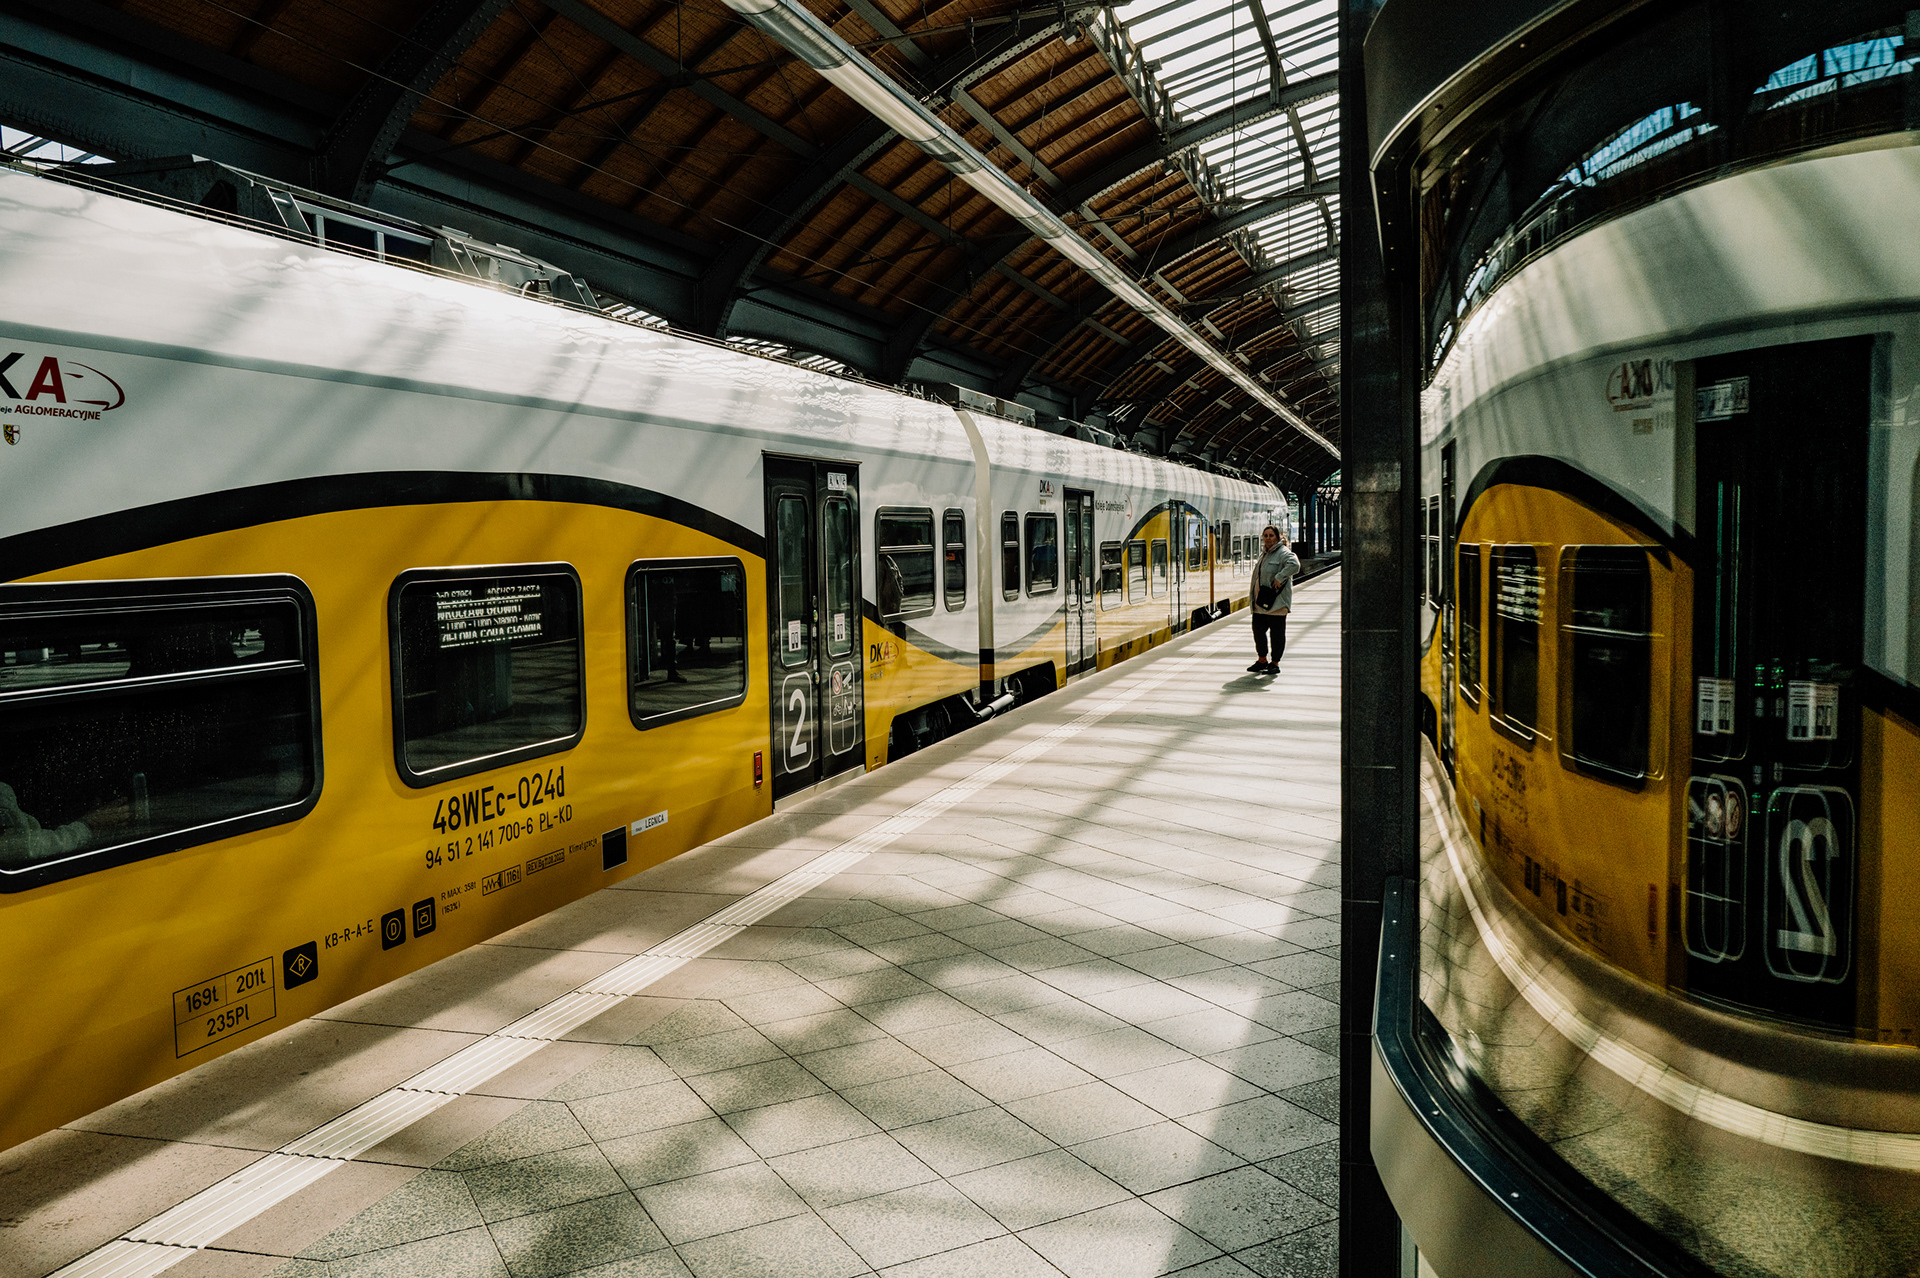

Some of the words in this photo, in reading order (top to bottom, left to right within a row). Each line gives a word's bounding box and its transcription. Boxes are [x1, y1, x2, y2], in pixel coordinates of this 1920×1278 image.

[14, 404, 101, 421] AGLOMERACYJNE
[870, 641, 890, 664] DKA
[789, 688, 808, 758] 2
[433, 765, 565, 835] 48WEc-024d
[425, 846, 442, 870] 94
[447, 840, 460, 862] 51
[465, 836, 473, 857] 2
[477, 829, 494, 852] 141
[498, 816, 534, 846] 700-6
[540, 804, 573, 832] PL-KD
[506, 868, 520, 884] 116t
[440, 892, 447, 901] R
[447, 886, 463, 898] MAX:
[463, 881, 477, 893] 358t
[325, 919, 374, 950] KB-R-A-E
[298, 957, 305, 973] R
[185, 985, 220, 1014] 169t
[236, 967, 267, 994] 201t
